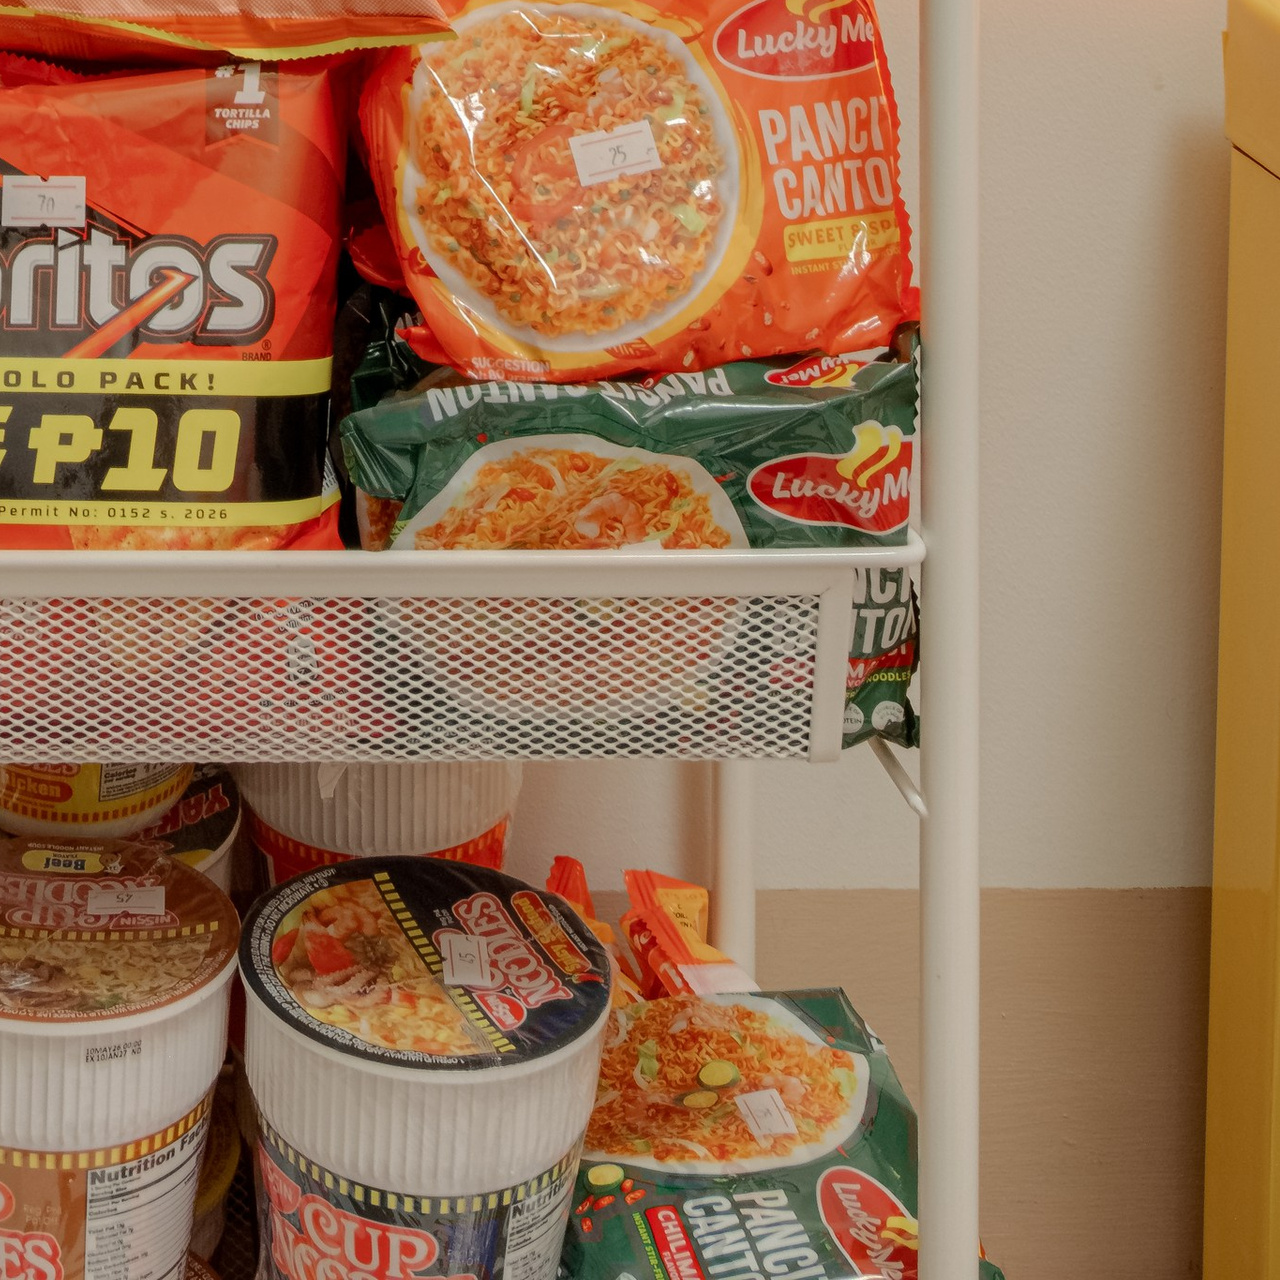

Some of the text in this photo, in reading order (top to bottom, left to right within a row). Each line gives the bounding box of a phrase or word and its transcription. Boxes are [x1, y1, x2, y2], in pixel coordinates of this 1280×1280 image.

[738, 20, 835, 60] Lucky
[214, 108, 271, 119] TORTILLA
[225, 118, 259, 129] CHIPS
[37, 194, 55, 212] 70
[788, 226, 844, 249] SWEET
[242, 352, 272, 361] BRAND
[100, 371, 217, 391] PACK!
[772, 472, 879, 518] Lucky
[69, 506, 99, 519] No:
[106, 507, 152, 519] 0152
[159, 510, 176, 519] s.
[185, 508, 229, 520] 2026
[44, 857, 86, 870] Beef
[279, 884, 314, 913] MICROWAVE
[121, 916, 171, 925] NISSIN
[459, 897, 565, 1004] NOODLES
[90, 1147, 175, 1185] Nutrition
[832, 1183, 883, 1248] Lucky
[301, 1200, 428, 1263] CUP
[632, 1212, 651, 1246] INSTANT
